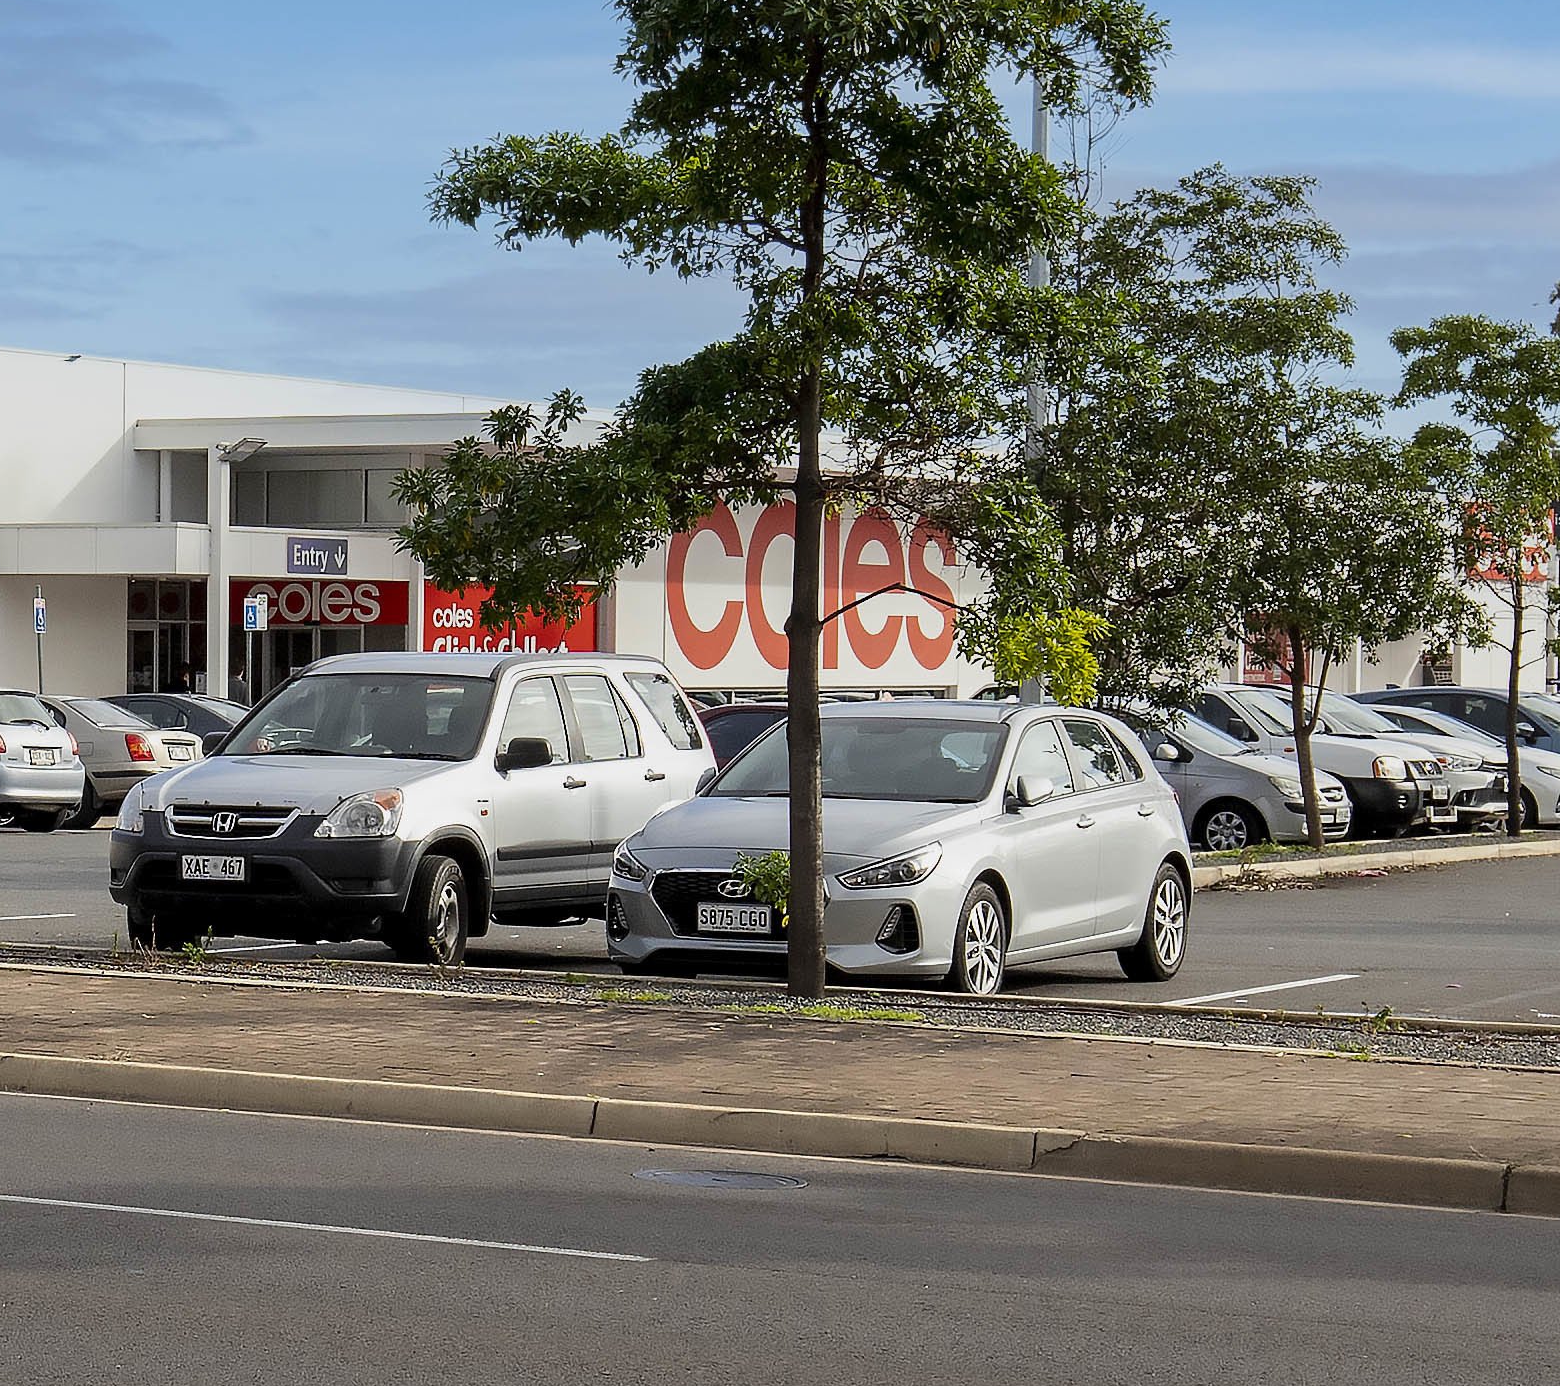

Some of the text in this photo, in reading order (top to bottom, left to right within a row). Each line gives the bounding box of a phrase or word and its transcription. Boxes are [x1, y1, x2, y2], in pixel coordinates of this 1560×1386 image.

[293, 544, 329, 573] Entry
[666, 493, 958, 671] coles
[247, 580, 381, 623] coles
[432, 603, 474, 628] coles
[184, 858, 243, 877] XAE 467
